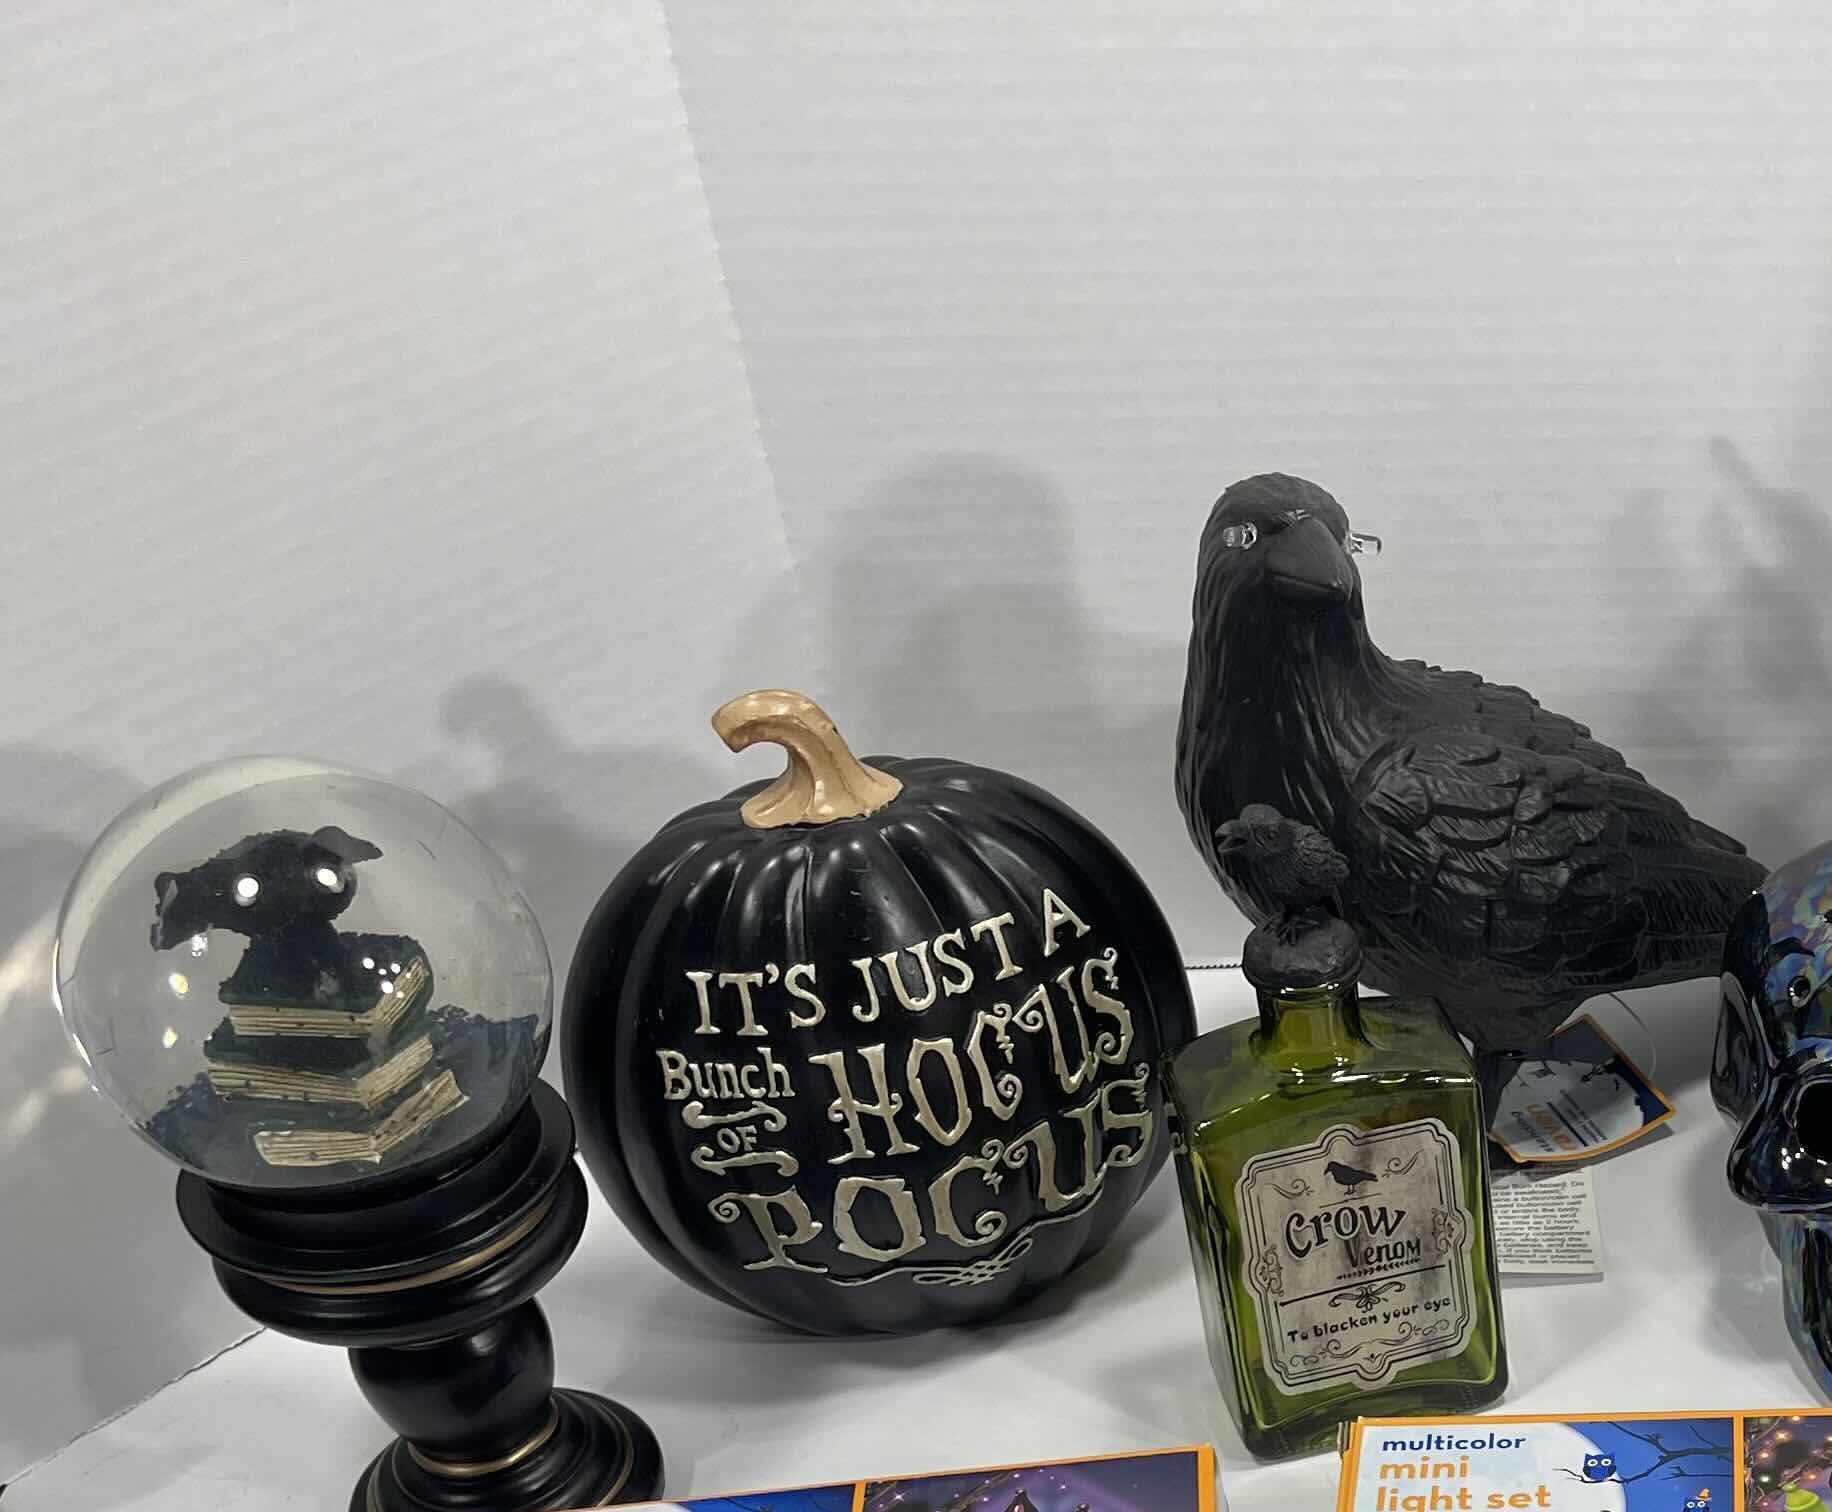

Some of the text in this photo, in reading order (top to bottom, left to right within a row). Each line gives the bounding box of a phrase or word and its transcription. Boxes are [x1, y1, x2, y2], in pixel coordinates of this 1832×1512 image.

[684, 887, 1091, 1038] IT'S JUST A
[655, 1046, 796, 1102] Bunch
[808, 947, 1135, 1166] HOCUS
[715, 1124, 761, 1155] OF
[707, 1062, 1154, 1275] POCUS
[1284, 1205, 1407, 1260] Crow
[1313, 1314, 1379, 1339] blacken
[1382, 1302, 1420, 1325] your
[1423, 1296, 1452, 1313] eye
[1382, 1432, 1527, 1452] multicolor
[1379, 1455, 1469, 1479] mini
[1487, 1484, 1551, 1510] set
